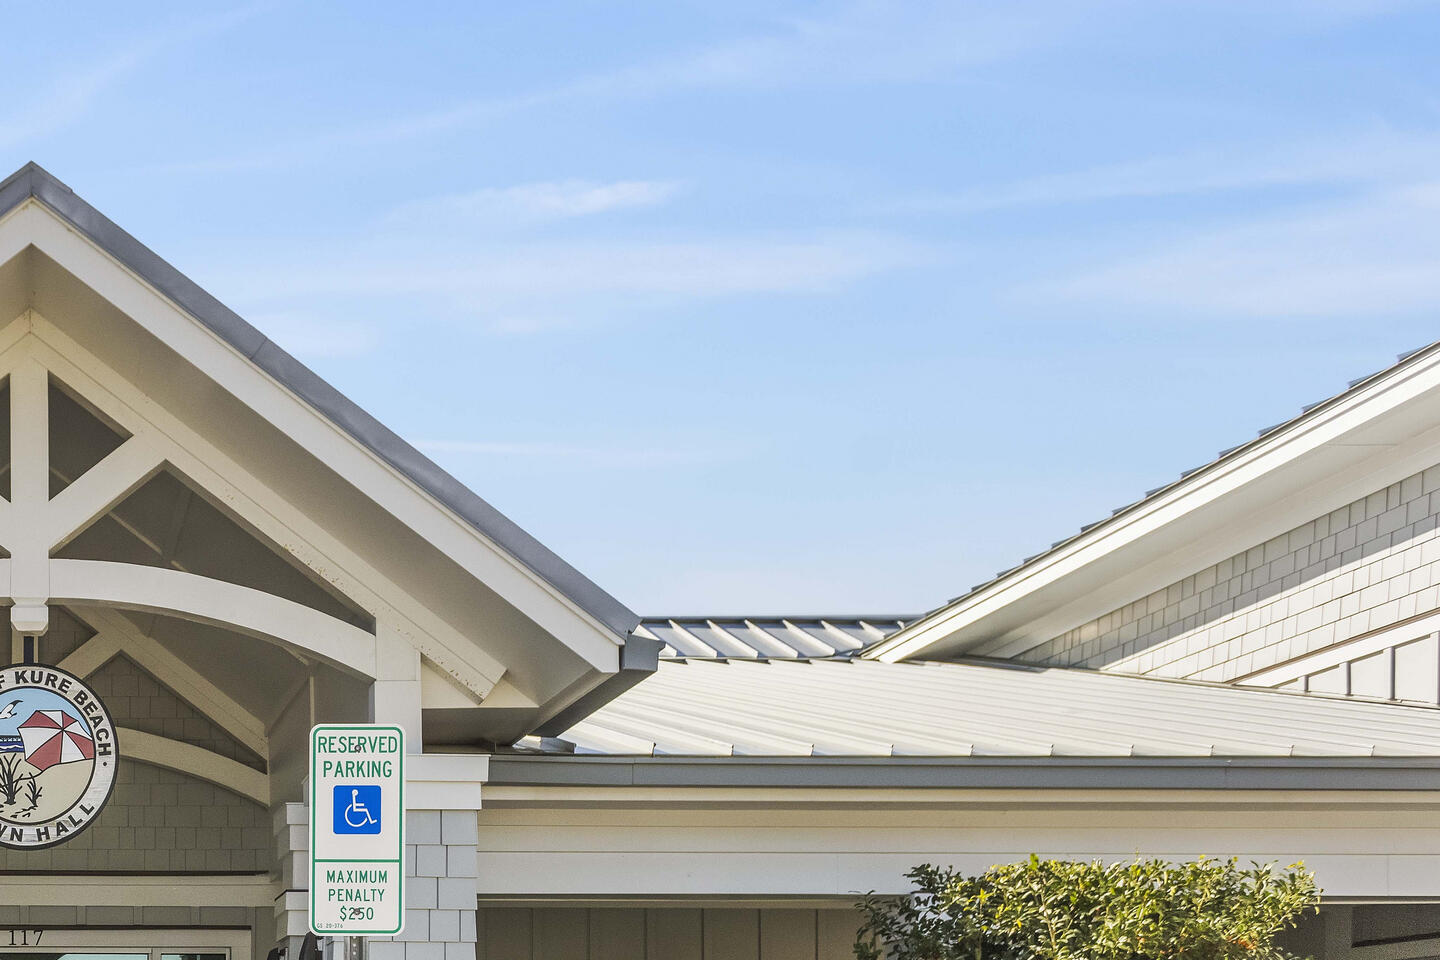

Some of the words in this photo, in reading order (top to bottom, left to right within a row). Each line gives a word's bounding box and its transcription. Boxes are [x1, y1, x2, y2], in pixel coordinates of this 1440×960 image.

[15, 670, 73, 694] KURE
[72, 692, 112, 756] BEACH
[318, 736, 398, 753] RESERVED
[323, 760, 392, 778] PARKING
[36, 803, 95, 842] HALL
[326, 870, 388, 883] MAXIMUM
[328, 888, 385, 902] PENALTY
[340, 905, 374, 921] $250
[8, 930, 44, 946] 117
